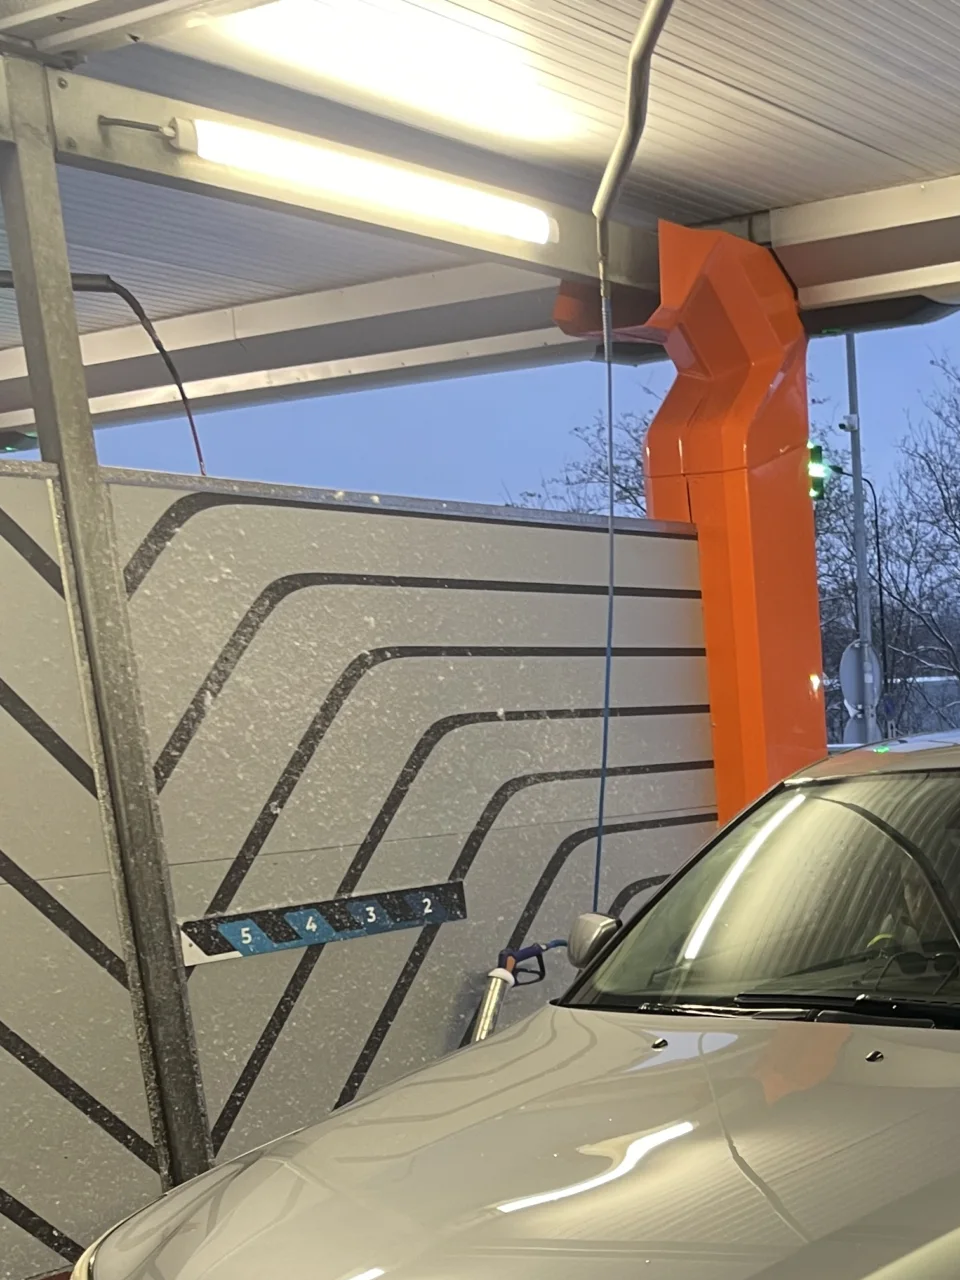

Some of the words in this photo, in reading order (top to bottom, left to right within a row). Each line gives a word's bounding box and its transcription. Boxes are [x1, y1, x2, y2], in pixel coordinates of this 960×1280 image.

[240, 926, 253, 945] 5
[304, 915, 318, 933] 4
[365, 905, 377, 924] 3
[421, 897, 434, 914] 2
